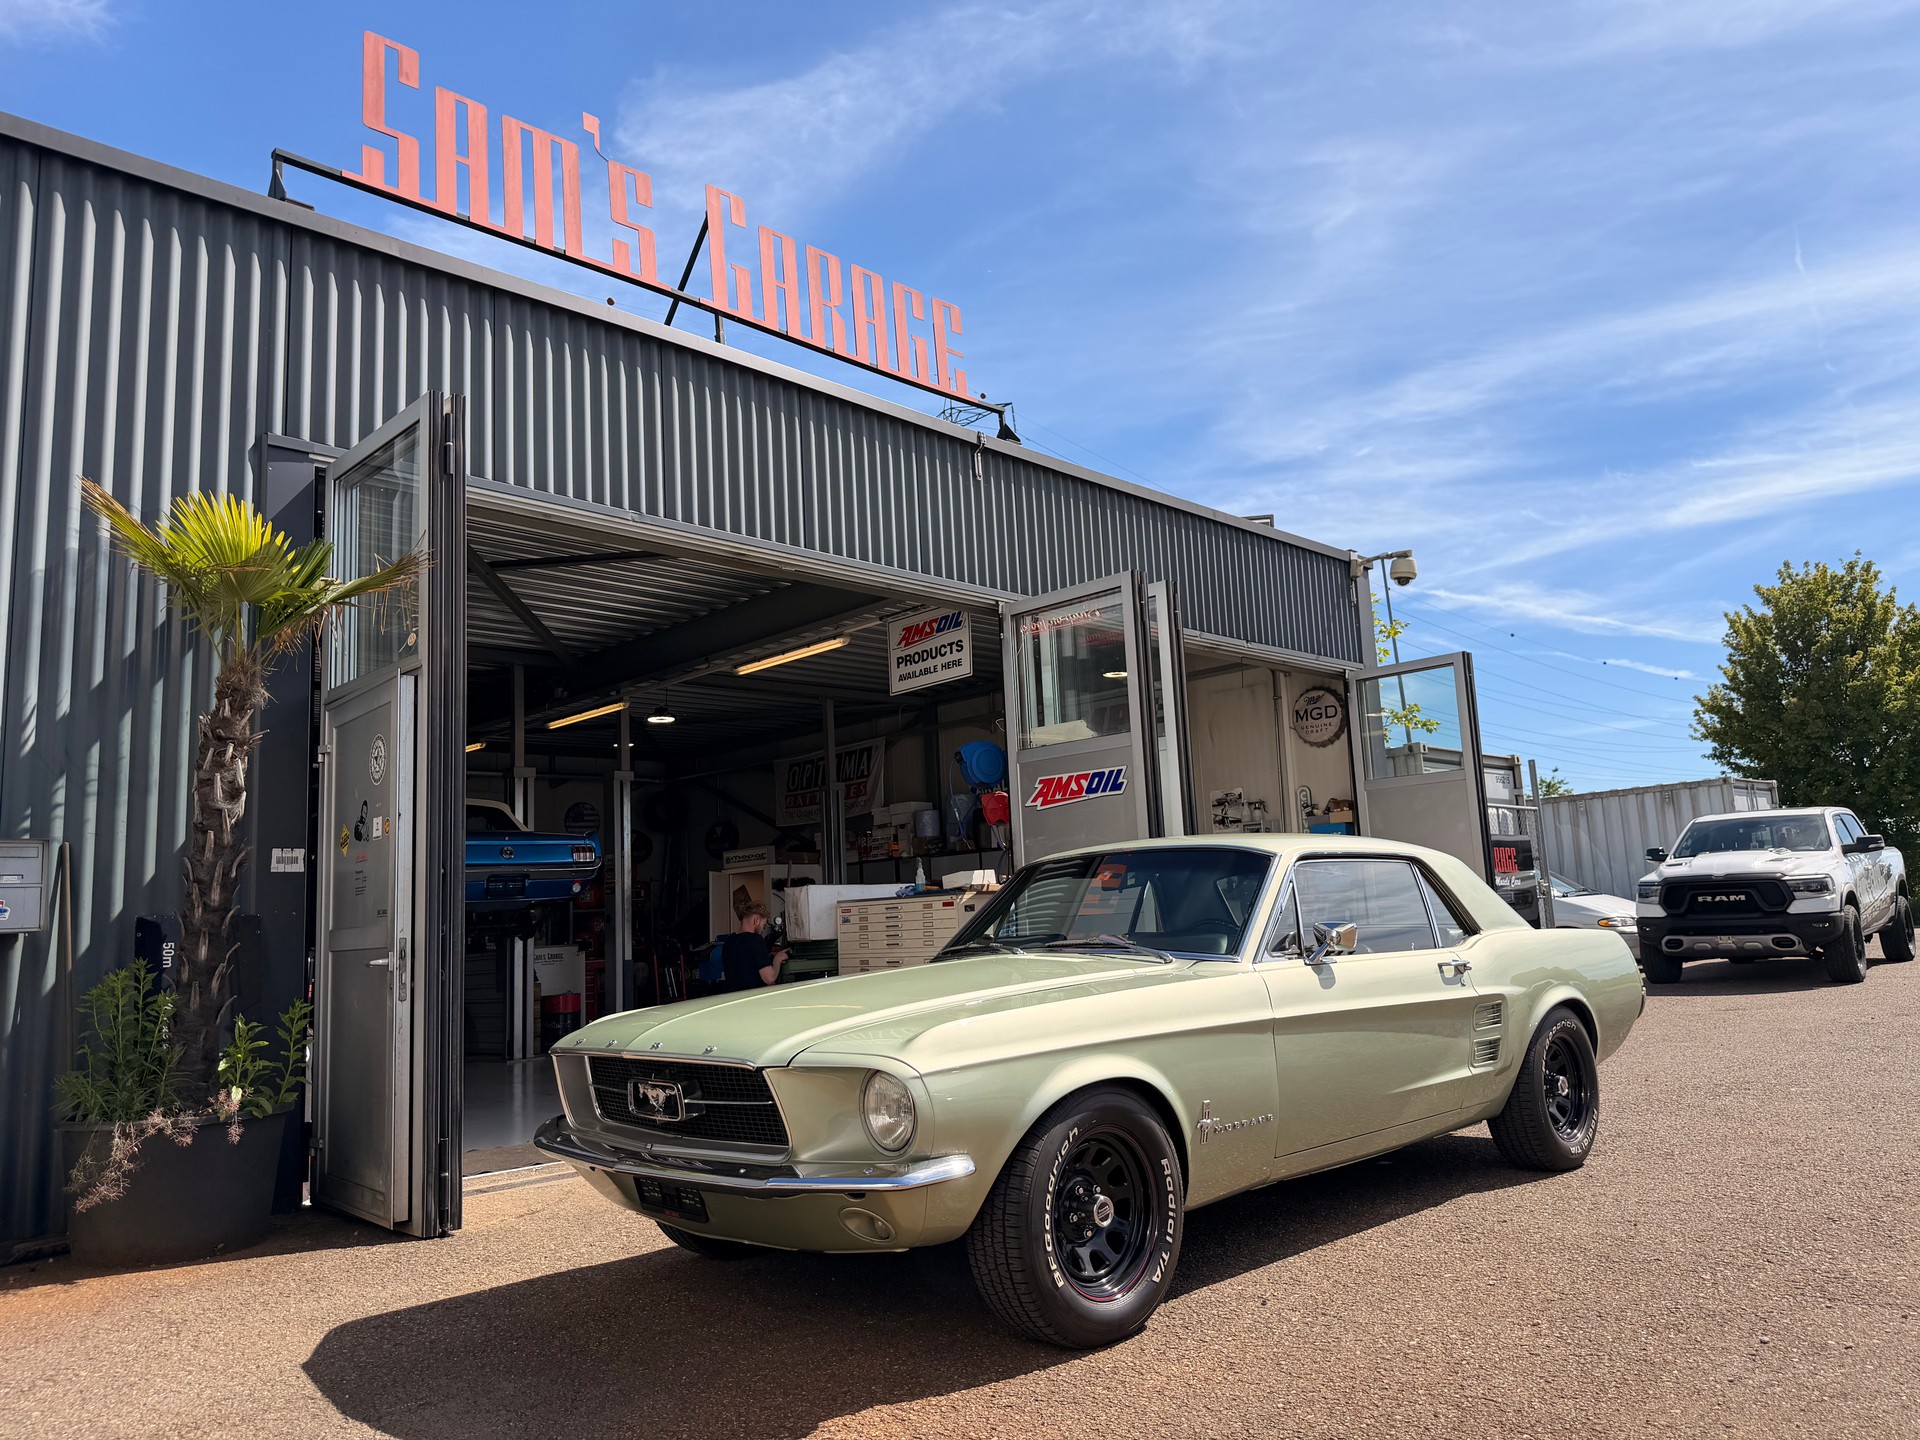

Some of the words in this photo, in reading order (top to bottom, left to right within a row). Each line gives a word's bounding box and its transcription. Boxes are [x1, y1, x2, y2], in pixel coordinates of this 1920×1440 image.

[699, 184, 980, 403] GARAGE
[896, 610, 965, 649] AMSOIL
[896, 639, 964, 669] PRODUCTS
[898, 665, 938, 682] AVAILABLE
[941, 658, 963, 672] HERE
[1295, 705, 1338, 722] MGD
[1301, 722, 1333, 730] GENUINE
[1306, 727, 1329, 735] DRAFT
[788, 751, 869, 790] OPTMA
[786, 783, 867, 807] BATTES
[1029, 768, 1125, 807] AMSOIL
[1494, 847, 1519, 873] RAGE
[162, 942, 175, 968] 50m
[1044, 1125, 1079, 1288] BFGoodrich
[1160, 1158, 1176, 1243] Radial
[1152, 1250, 1170, 1283] T/A
